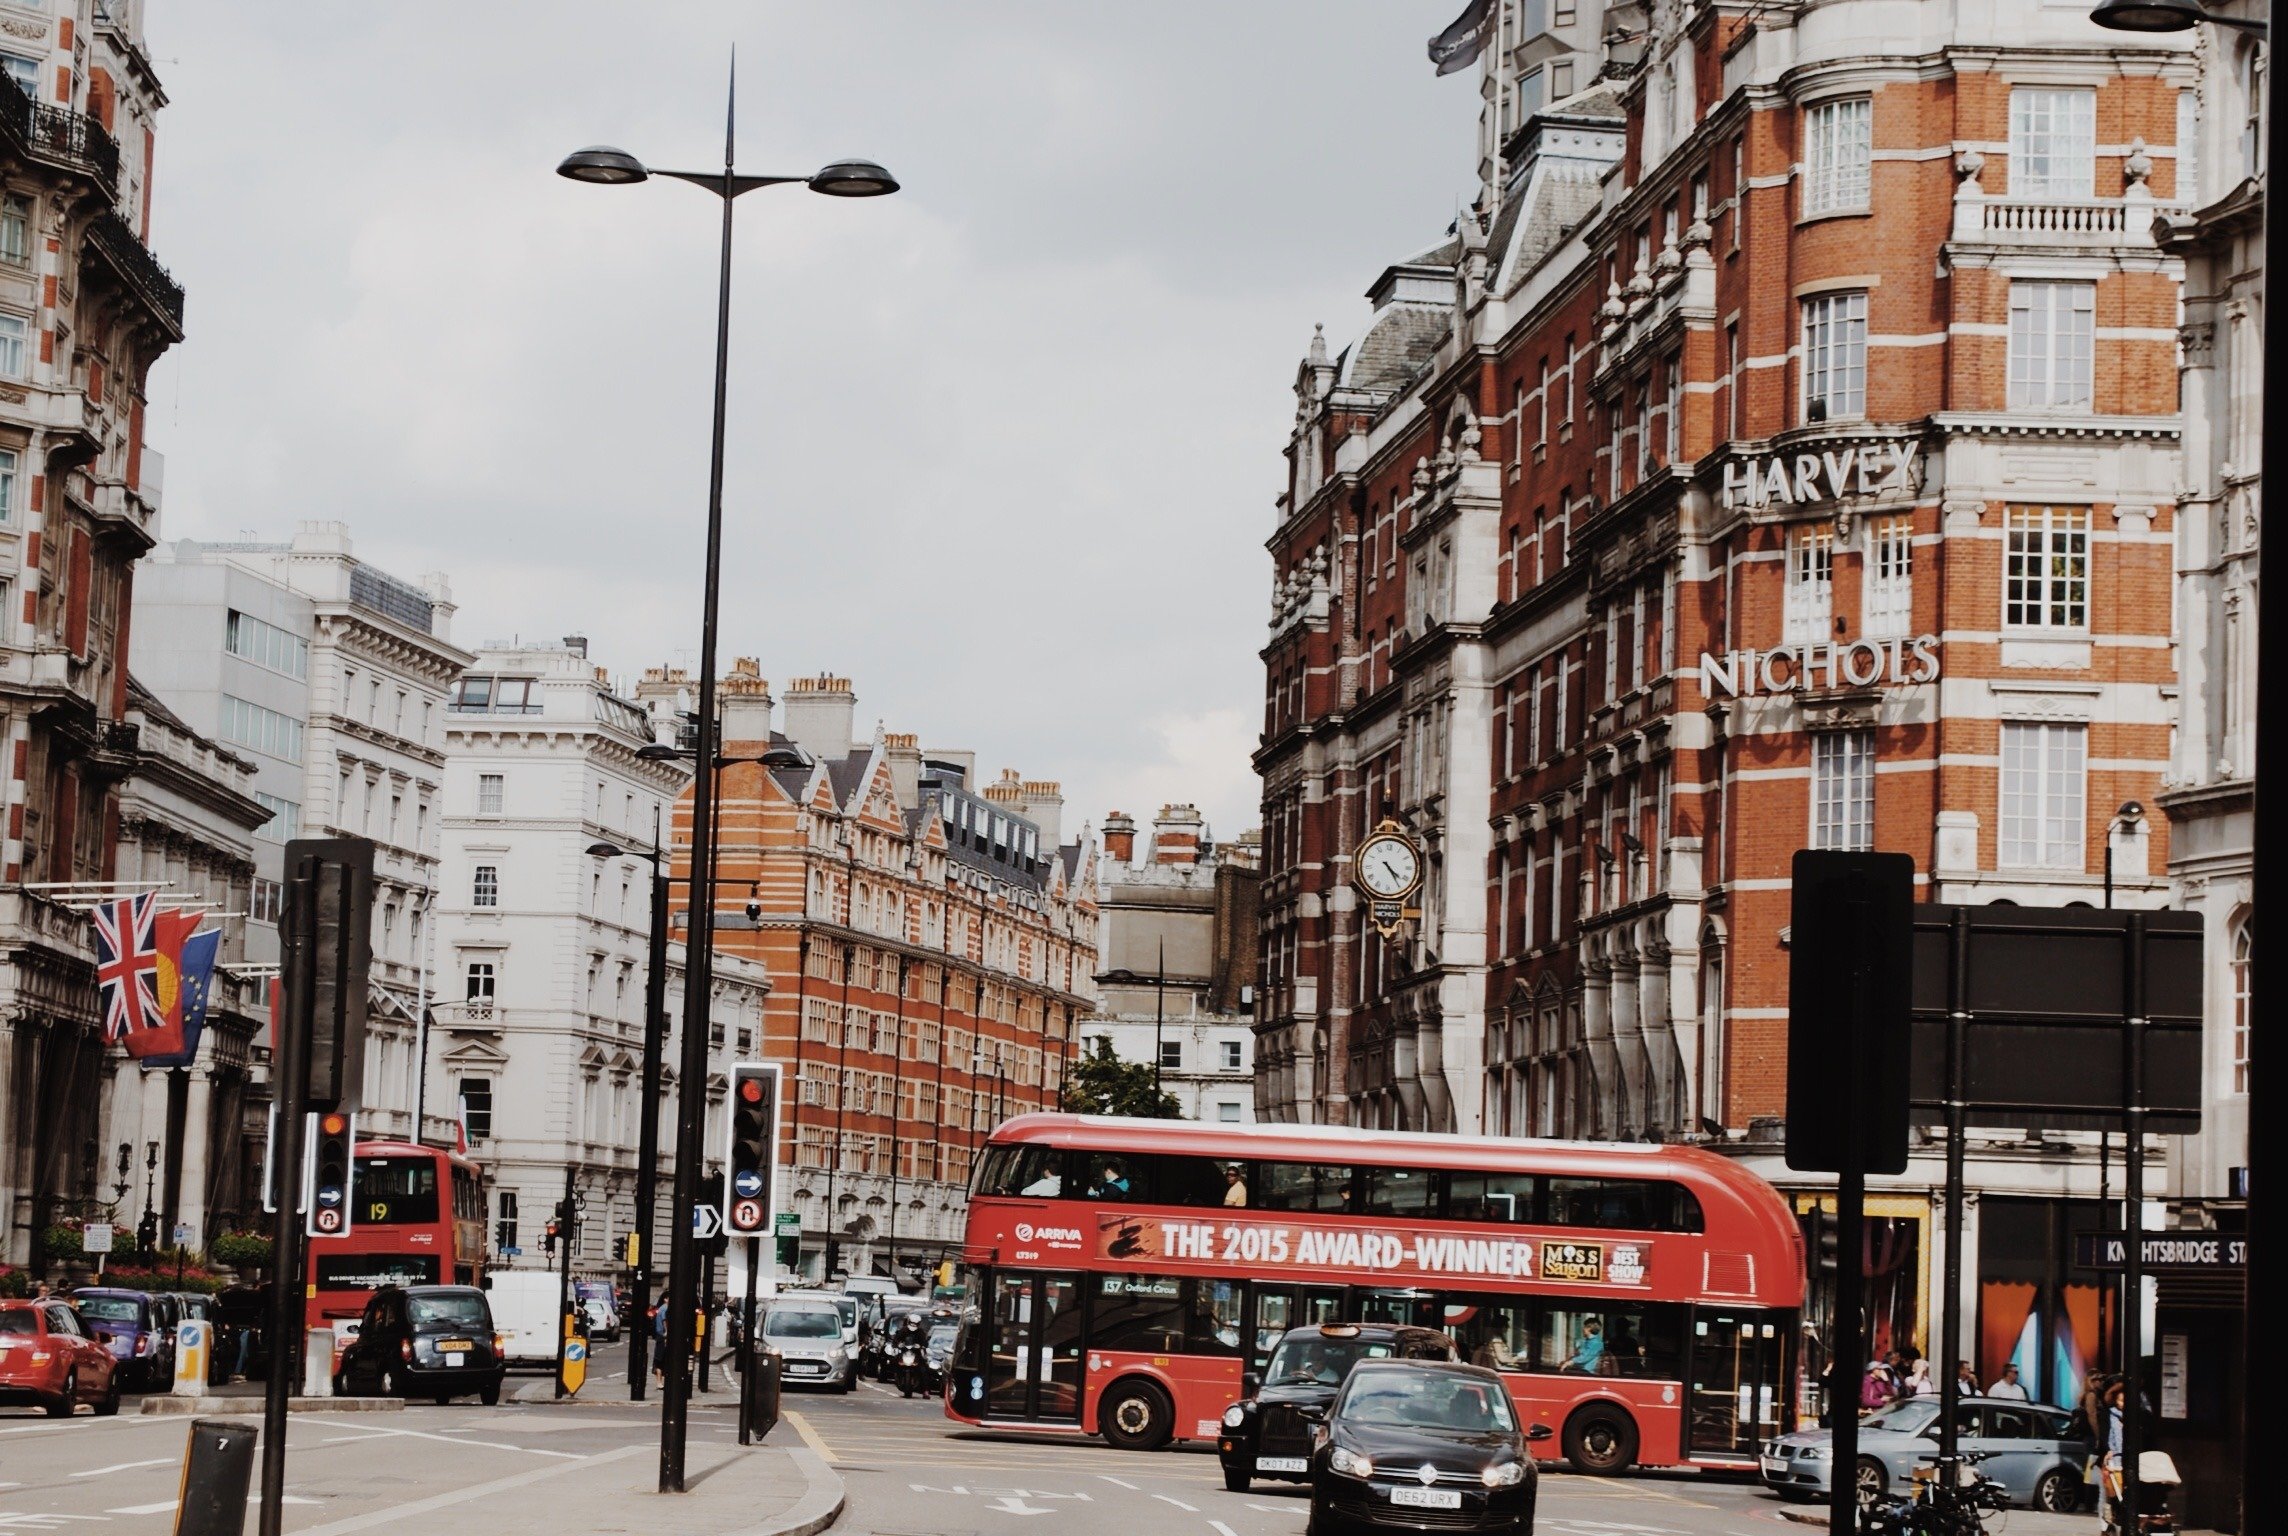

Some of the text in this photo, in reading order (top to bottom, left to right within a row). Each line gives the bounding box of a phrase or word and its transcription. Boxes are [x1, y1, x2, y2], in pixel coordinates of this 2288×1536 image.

[1723, 441, 1918, 509] HARVEY
[1701, 634, 1940, 700] NICHOLS
[371, 1203, 387, 1220] 19
[1035, 1227, 1082, 1241] ARRIVA
[1162, 1223, 1532, 1277] THE 2015 AWARD-WINNER
[1612, 1251, 1640, 1265] BEST
[2107, 1241, 2219, 1263] KNHTSBRIDGE
[1545, 1261, 1598, 1279] Saigon
[1607, 1264, 1644, 1278] SHOW
[1104, 1281, 1177, 1294] 137 Oxford Circus
[218, 1438, 229, 1451] 7
[1396, 1490, 1454, 1506] OE62 URX
